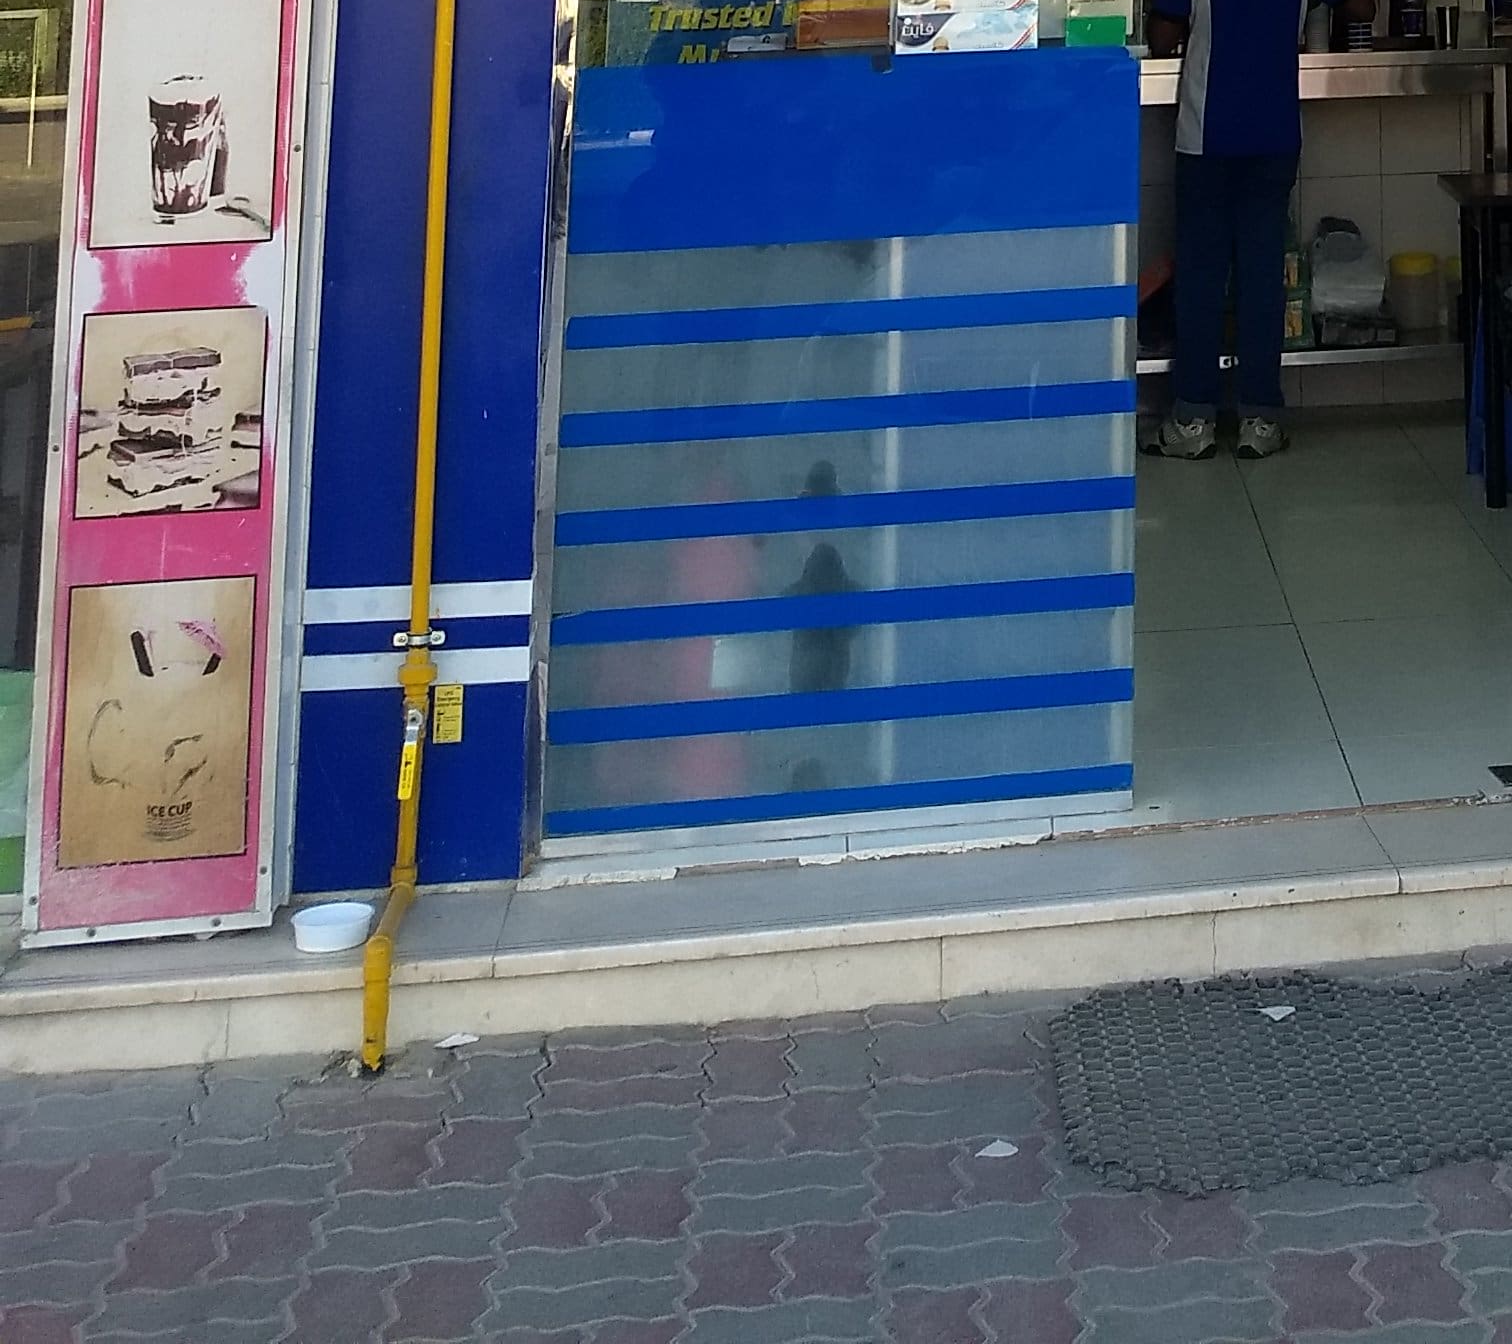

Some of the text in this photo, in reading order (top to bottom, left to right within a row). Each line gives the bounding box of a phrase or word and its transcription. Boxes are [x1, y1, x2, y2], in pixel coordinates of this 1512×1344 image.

[650, 2, 777, 32] Trusted
[147, 801, 192, 818] ICE CUP
